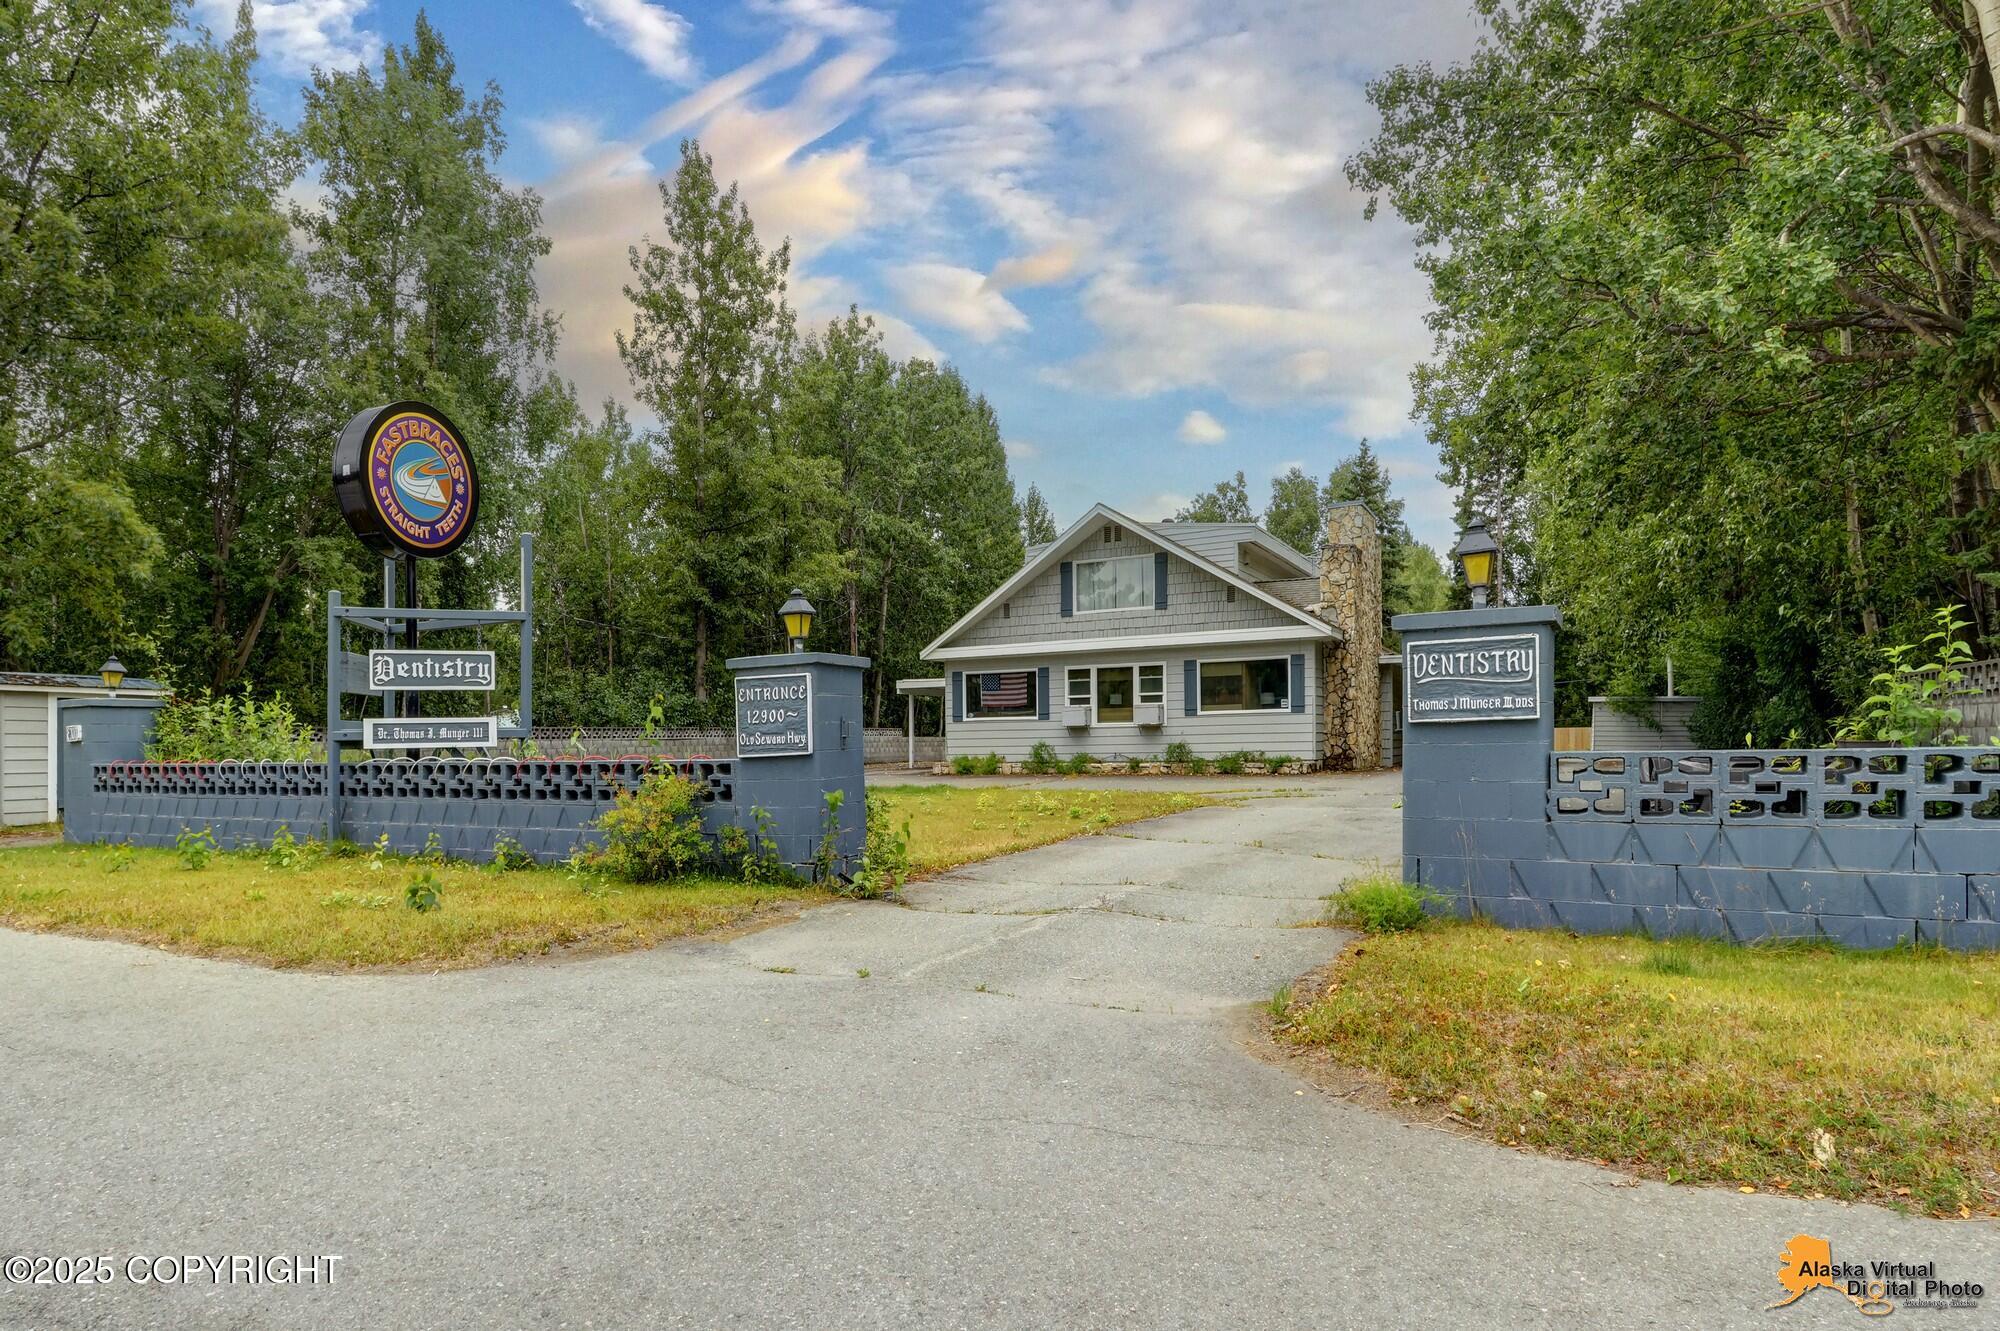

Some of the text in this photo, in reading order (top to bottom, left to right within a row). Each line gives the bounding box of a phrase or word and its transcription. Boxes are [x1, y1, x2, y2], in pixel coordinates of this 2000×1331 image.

[379, 486, 463, 539] STRAIGHT TEETH
[373, 655, 491, 685] Dentistry
[1413, 649, 1533, 684] DENTISTRY
[738, 685, 806, 702] ENTRANCE
[1451, 695, 1457, 710] J
[377, 727, 391, 739] Dr.
[393, 727, 425, 742] Thomas
[439, 727, 470, 740] Munger
